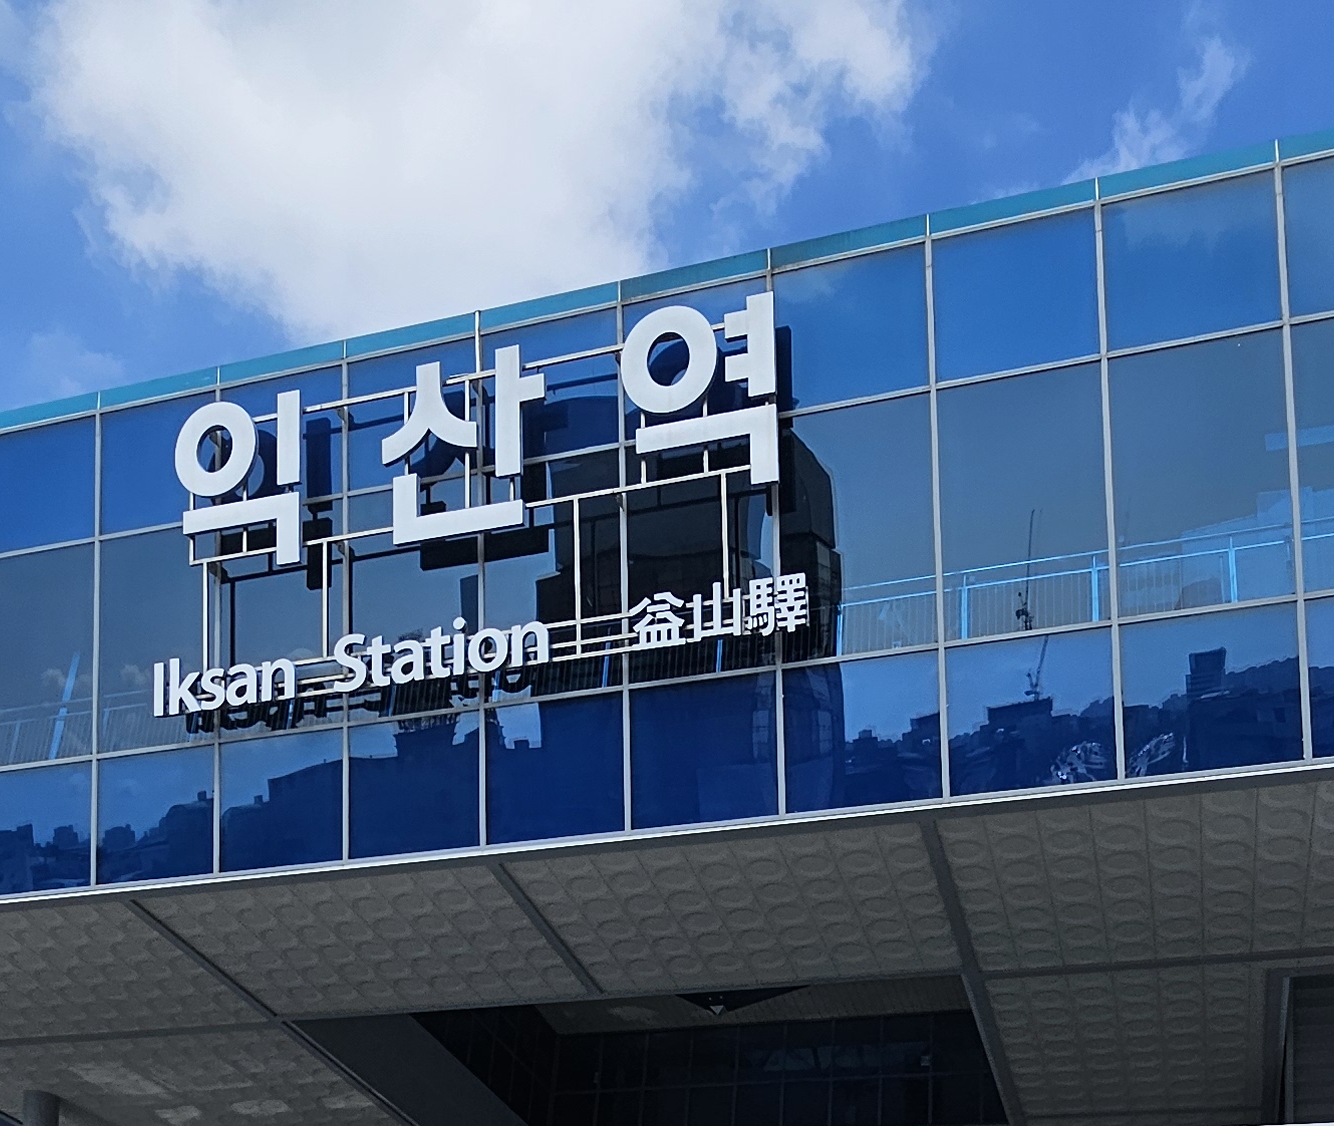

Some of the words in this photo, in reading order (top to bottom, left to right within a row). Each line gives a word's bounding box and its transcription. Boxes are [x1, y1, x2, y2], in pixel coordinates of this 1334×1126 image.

[628, 572, 810, 649] 益山驛
[153, 656, 297, 717] Iksan
[333, 616, 550, 693] Station
